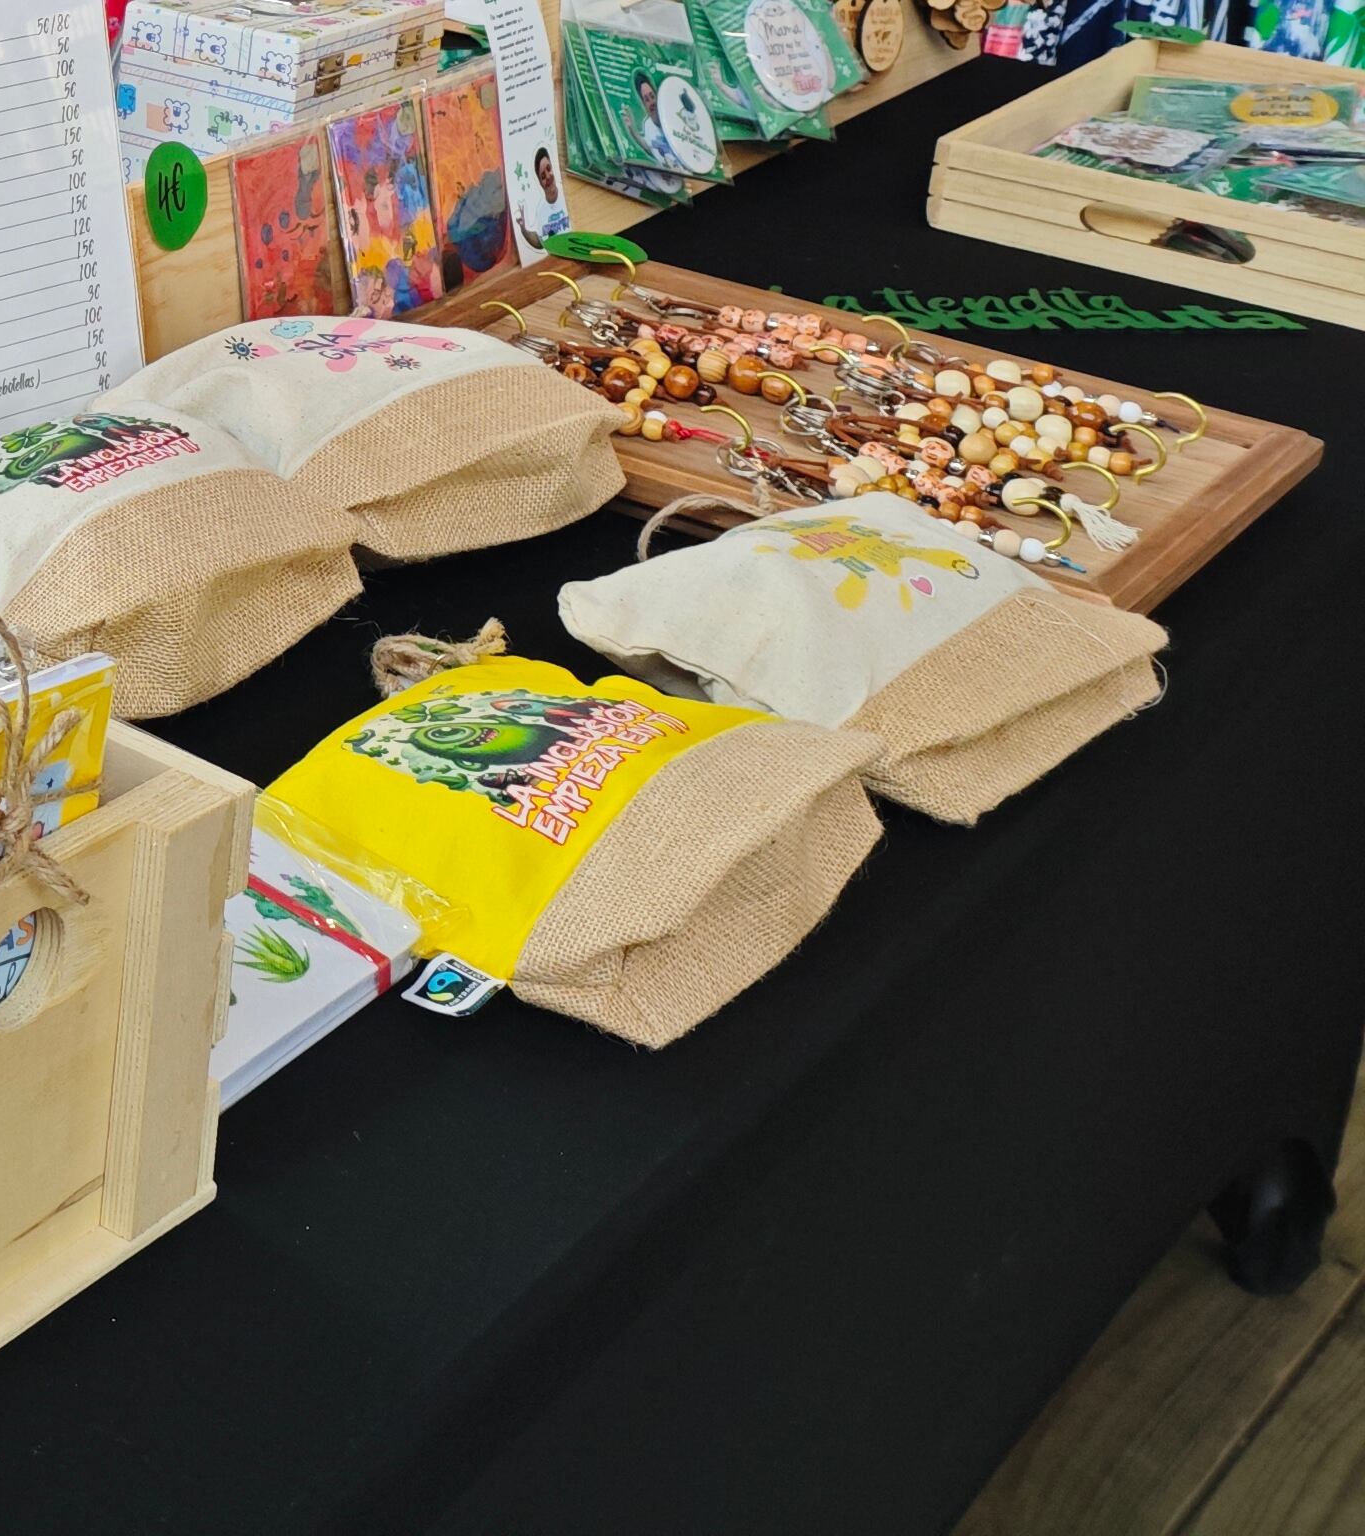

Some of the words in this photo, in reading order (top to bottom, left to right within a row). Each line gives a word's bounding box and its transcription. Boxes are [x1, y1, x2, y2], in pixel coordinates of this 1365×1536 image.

[156, 161, 187, 224] 4€
[64, 453, 144, 494] EMPIEZA
[80, 424, 176, 471] INCLUSIÓN
[491, 781, 552, 828] LA
[523, 698, 656, 785] INCLUSIÓN
[530, 742, 642, 846] EMPIEZA
[614, 721, 671, 749] EN
[645, 709, 691, 735] TI
